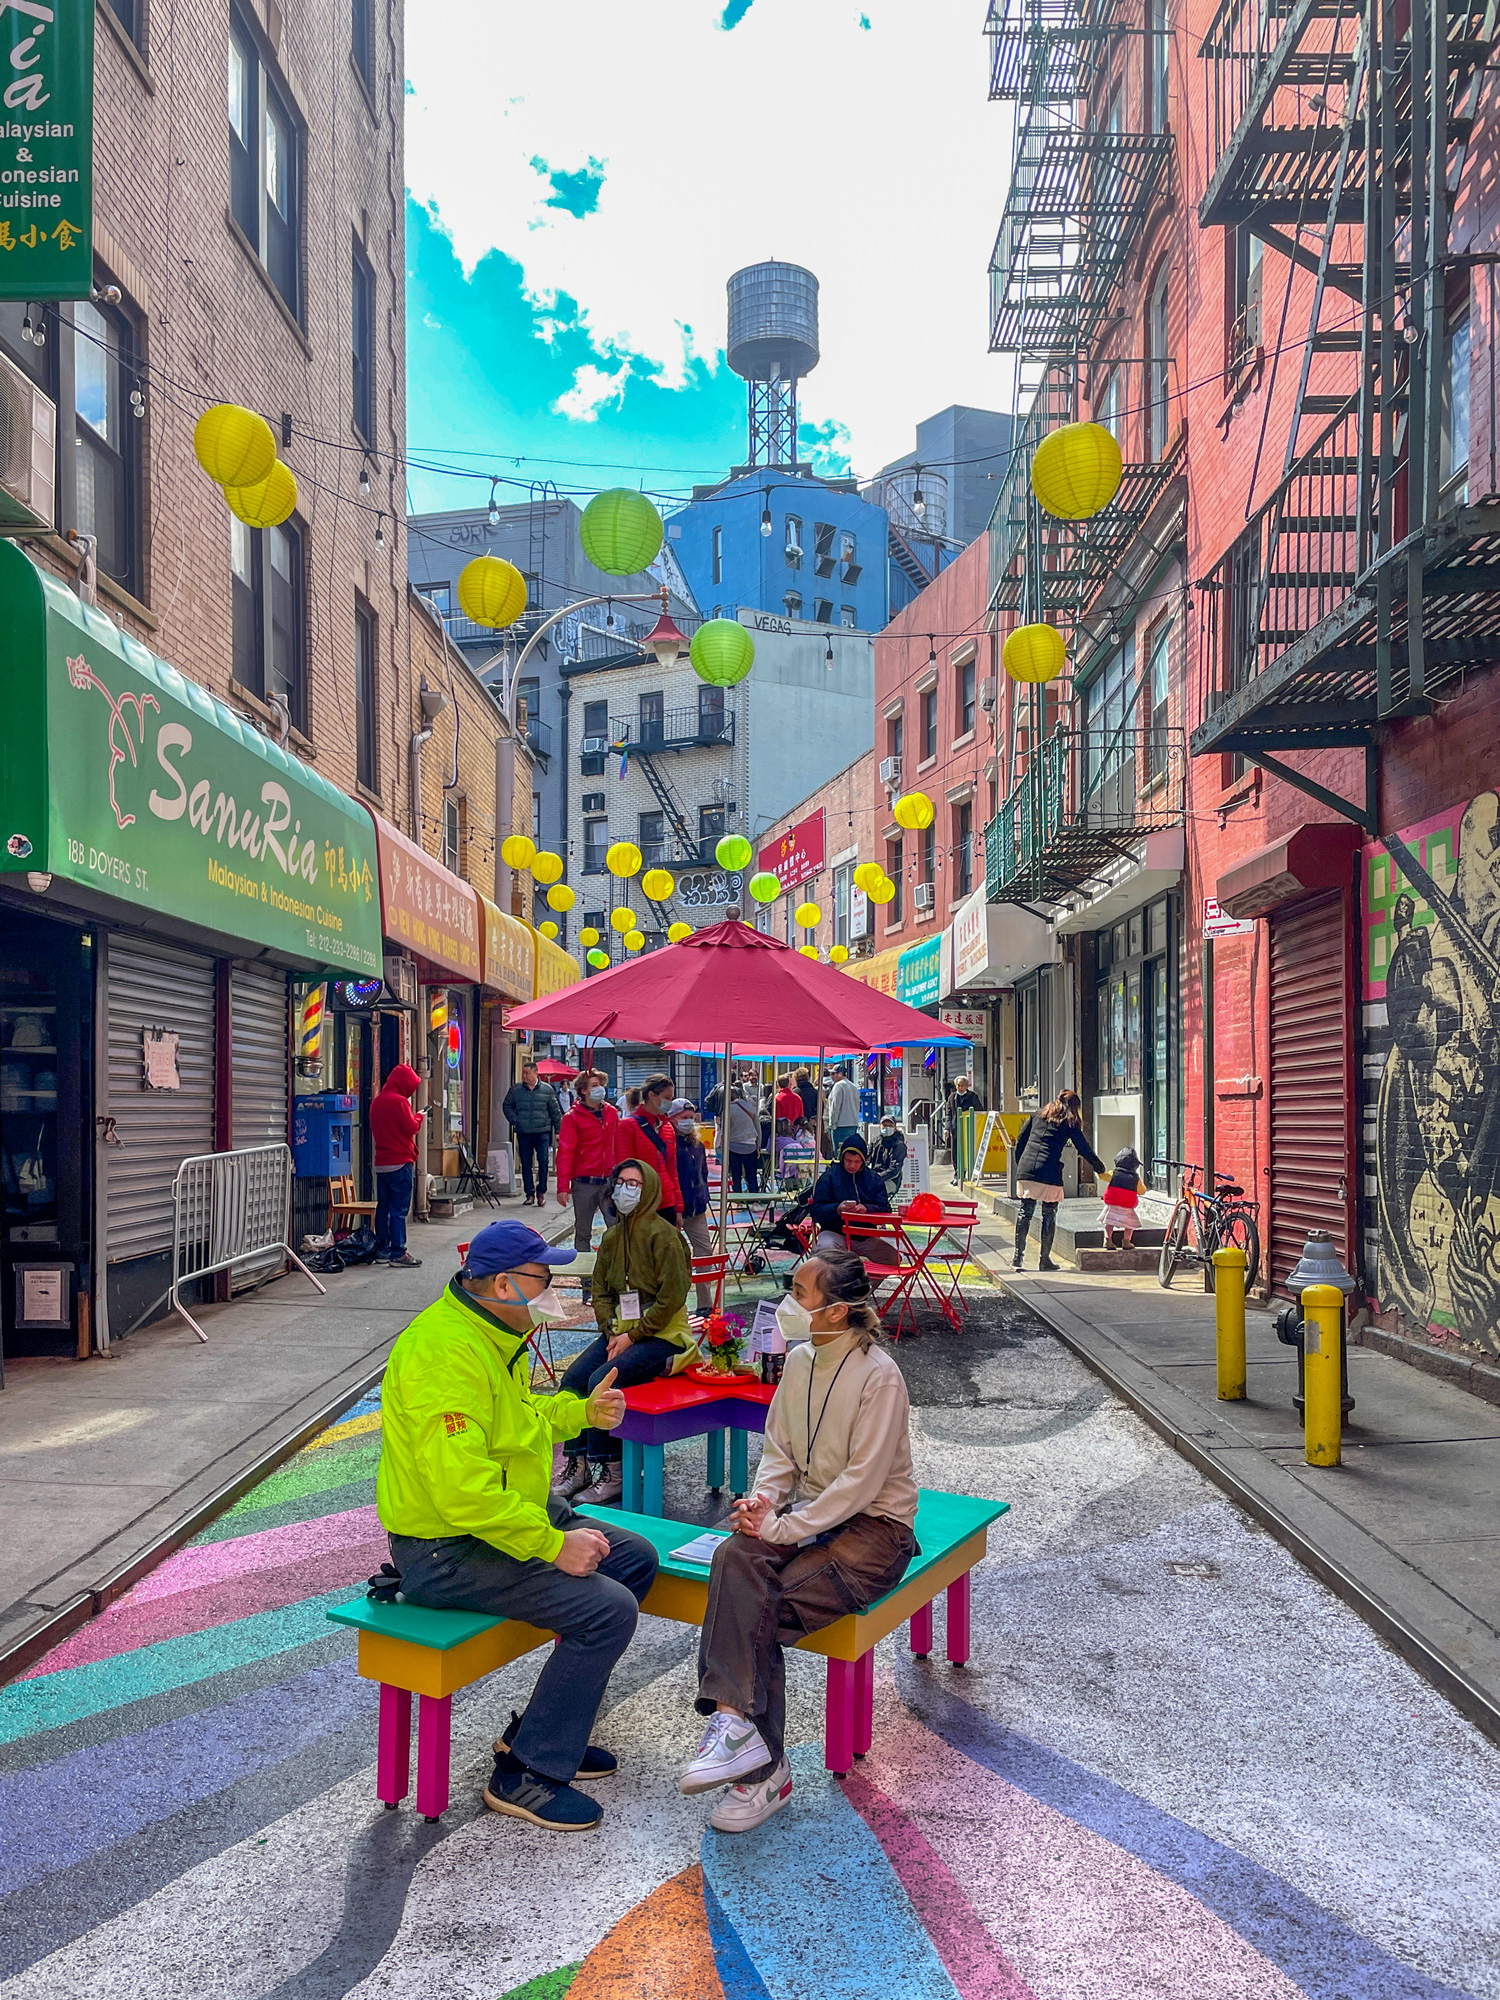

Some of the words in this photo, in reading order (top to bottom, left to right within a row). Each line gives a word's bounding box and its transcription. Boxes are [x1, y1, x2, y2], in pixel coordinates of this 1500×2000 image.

[16, 147, 33, 162] &
[0, 190, 61, 208] uisine
[755, 615, 792, 637] VEGAS
[149, 722, 319, 885] SanuRia
[68, 838, 85, 865] 18B
[89, 847, 131, 885] DOYERS
[135, 867, 149, 892] ST.
[208, 857, 259, 900] Malaysian
[261, 881, 268, 903] &
[270, 885, 315, 922] Indonesian
[316, 905, 343, 932] Cuisine
[399, 907, 410, 937] NEW
[413, 915, 427, 947] HONG
[297, 1102, 325, 1111] ATM
